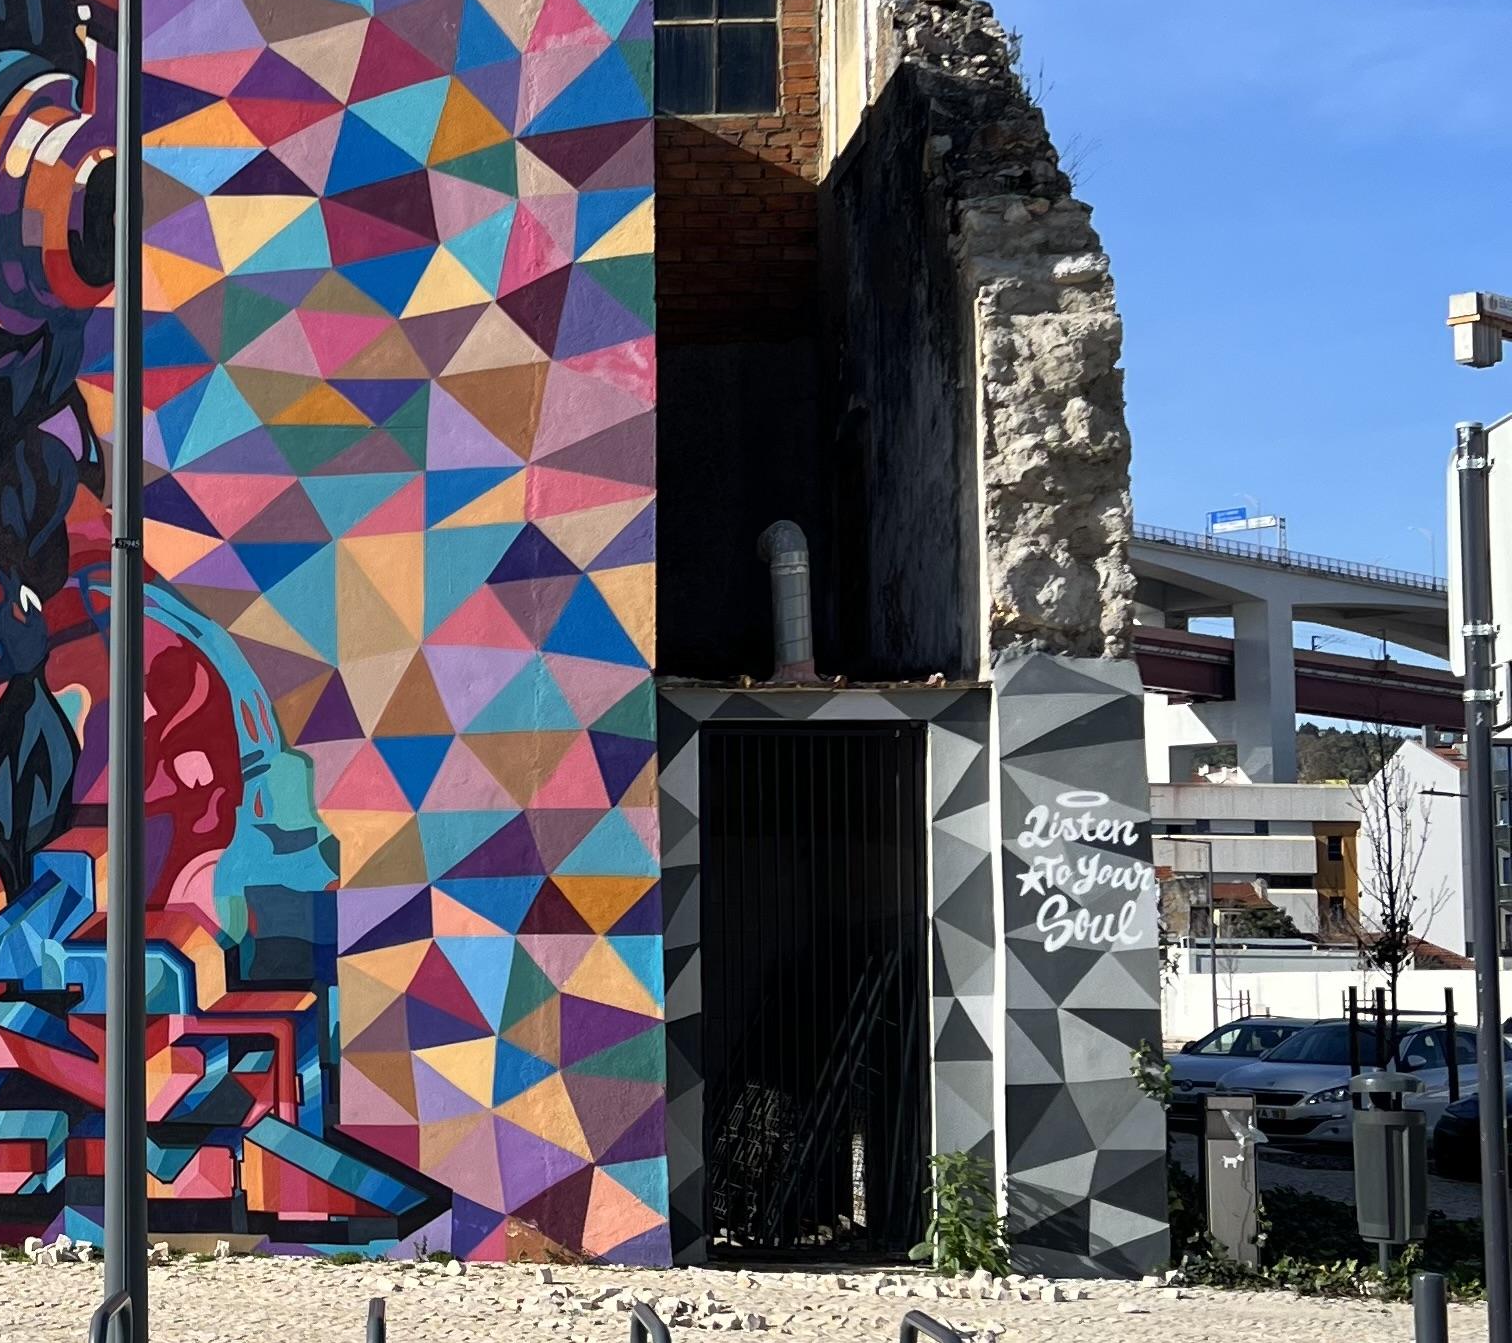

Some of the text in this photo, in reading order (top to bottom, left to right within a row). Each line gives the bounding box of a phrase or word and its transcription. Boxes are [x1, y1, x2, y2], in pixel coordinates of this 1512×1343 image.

[1017, 805, 1138, 848] Listen
[1034, 853, 1155, 894] To Your
[1036, 894, 1143, 952] Soul
